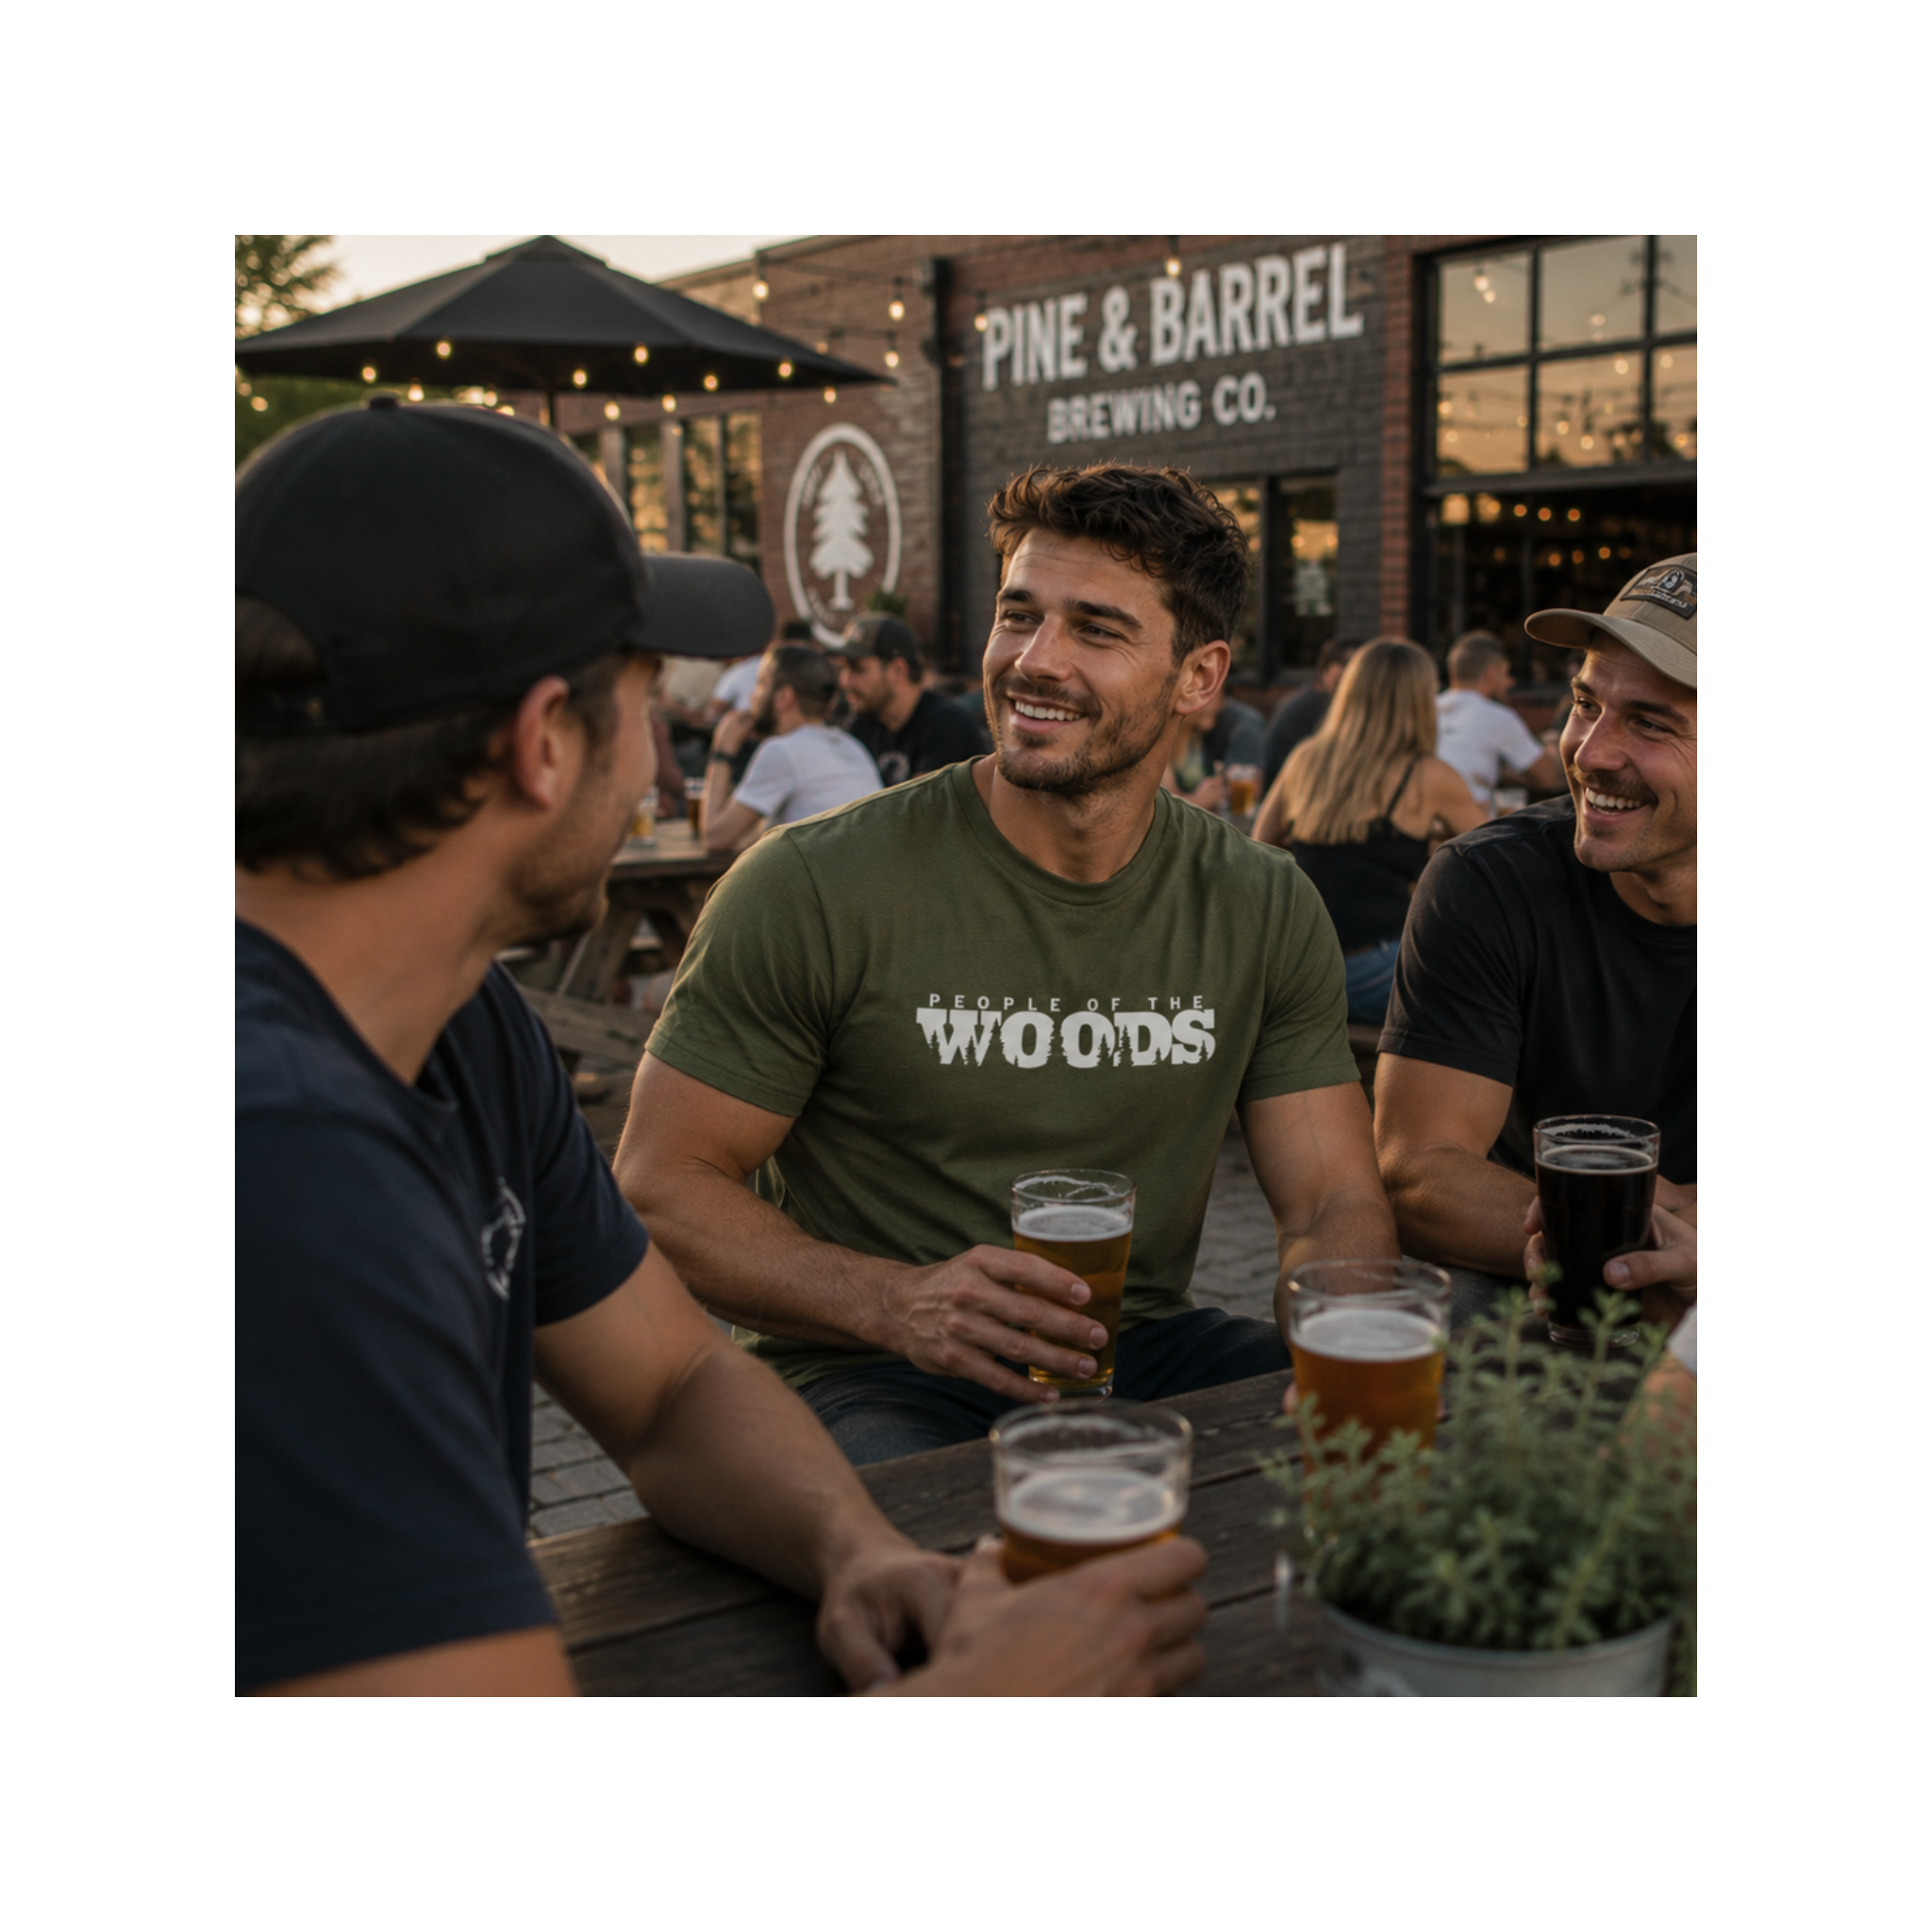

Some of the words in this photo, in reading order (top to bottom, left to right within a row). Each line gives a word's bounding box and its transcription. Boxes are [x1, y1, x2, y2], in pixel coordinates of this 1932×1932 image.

[981, 292, 1088, 391] PINE
[1097, 285, 1139, 374] &
[1150, 242, 1364, 367] BARREL
[1046, 379, 1201, 444] BREWING
[1212, 372, 1275, 426] CO.
[929, 993, 1060, 1012] PEOPLE
[1087, 997, 1121, 1011] OF
[1148, 995, 1203, 1010] THE
[916, 1008, 1216, 1069] WOODS
